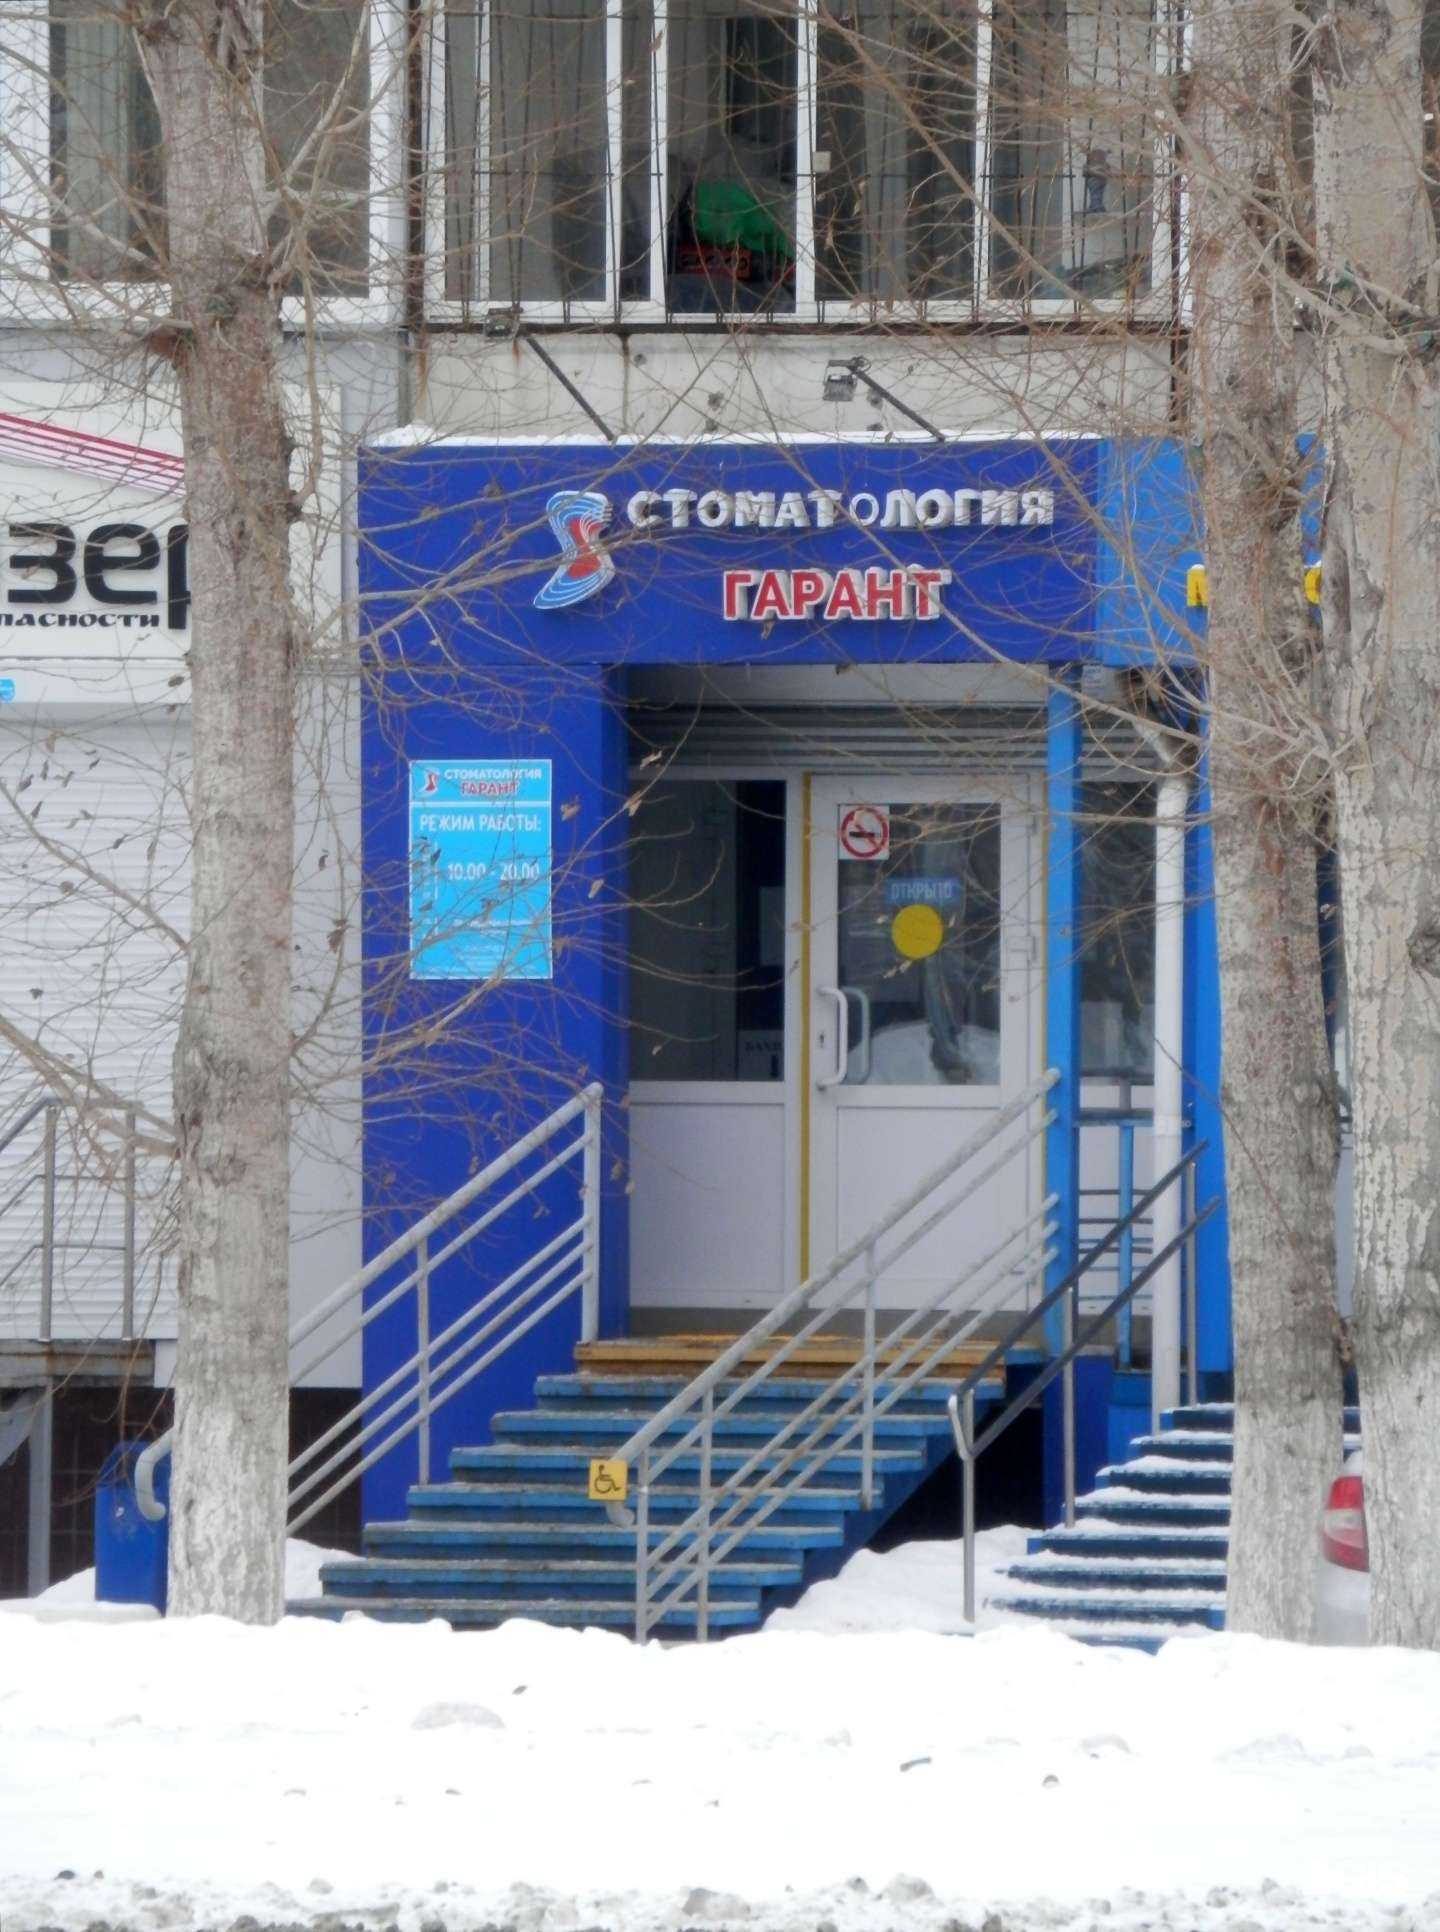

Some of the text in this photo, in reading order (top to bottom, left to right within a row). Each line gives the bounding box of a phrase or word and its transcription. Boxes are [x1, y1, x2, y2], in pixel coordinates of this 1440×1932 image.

[627, 488, 1055, 529] СТОМАТОЛОГИЯ
[723, 566, 952, 621] ГАРАНТ
[444, 768, 543, 781] СТОМАТОЛОГИЯ
[460, 780, 520, 797] ГАРАНТ
[419, 814, 475, 832] РЕЖИМ
[447, 863, 487, 881] 10.00
[890, 881, 953, 899] ОТКРЫТО
